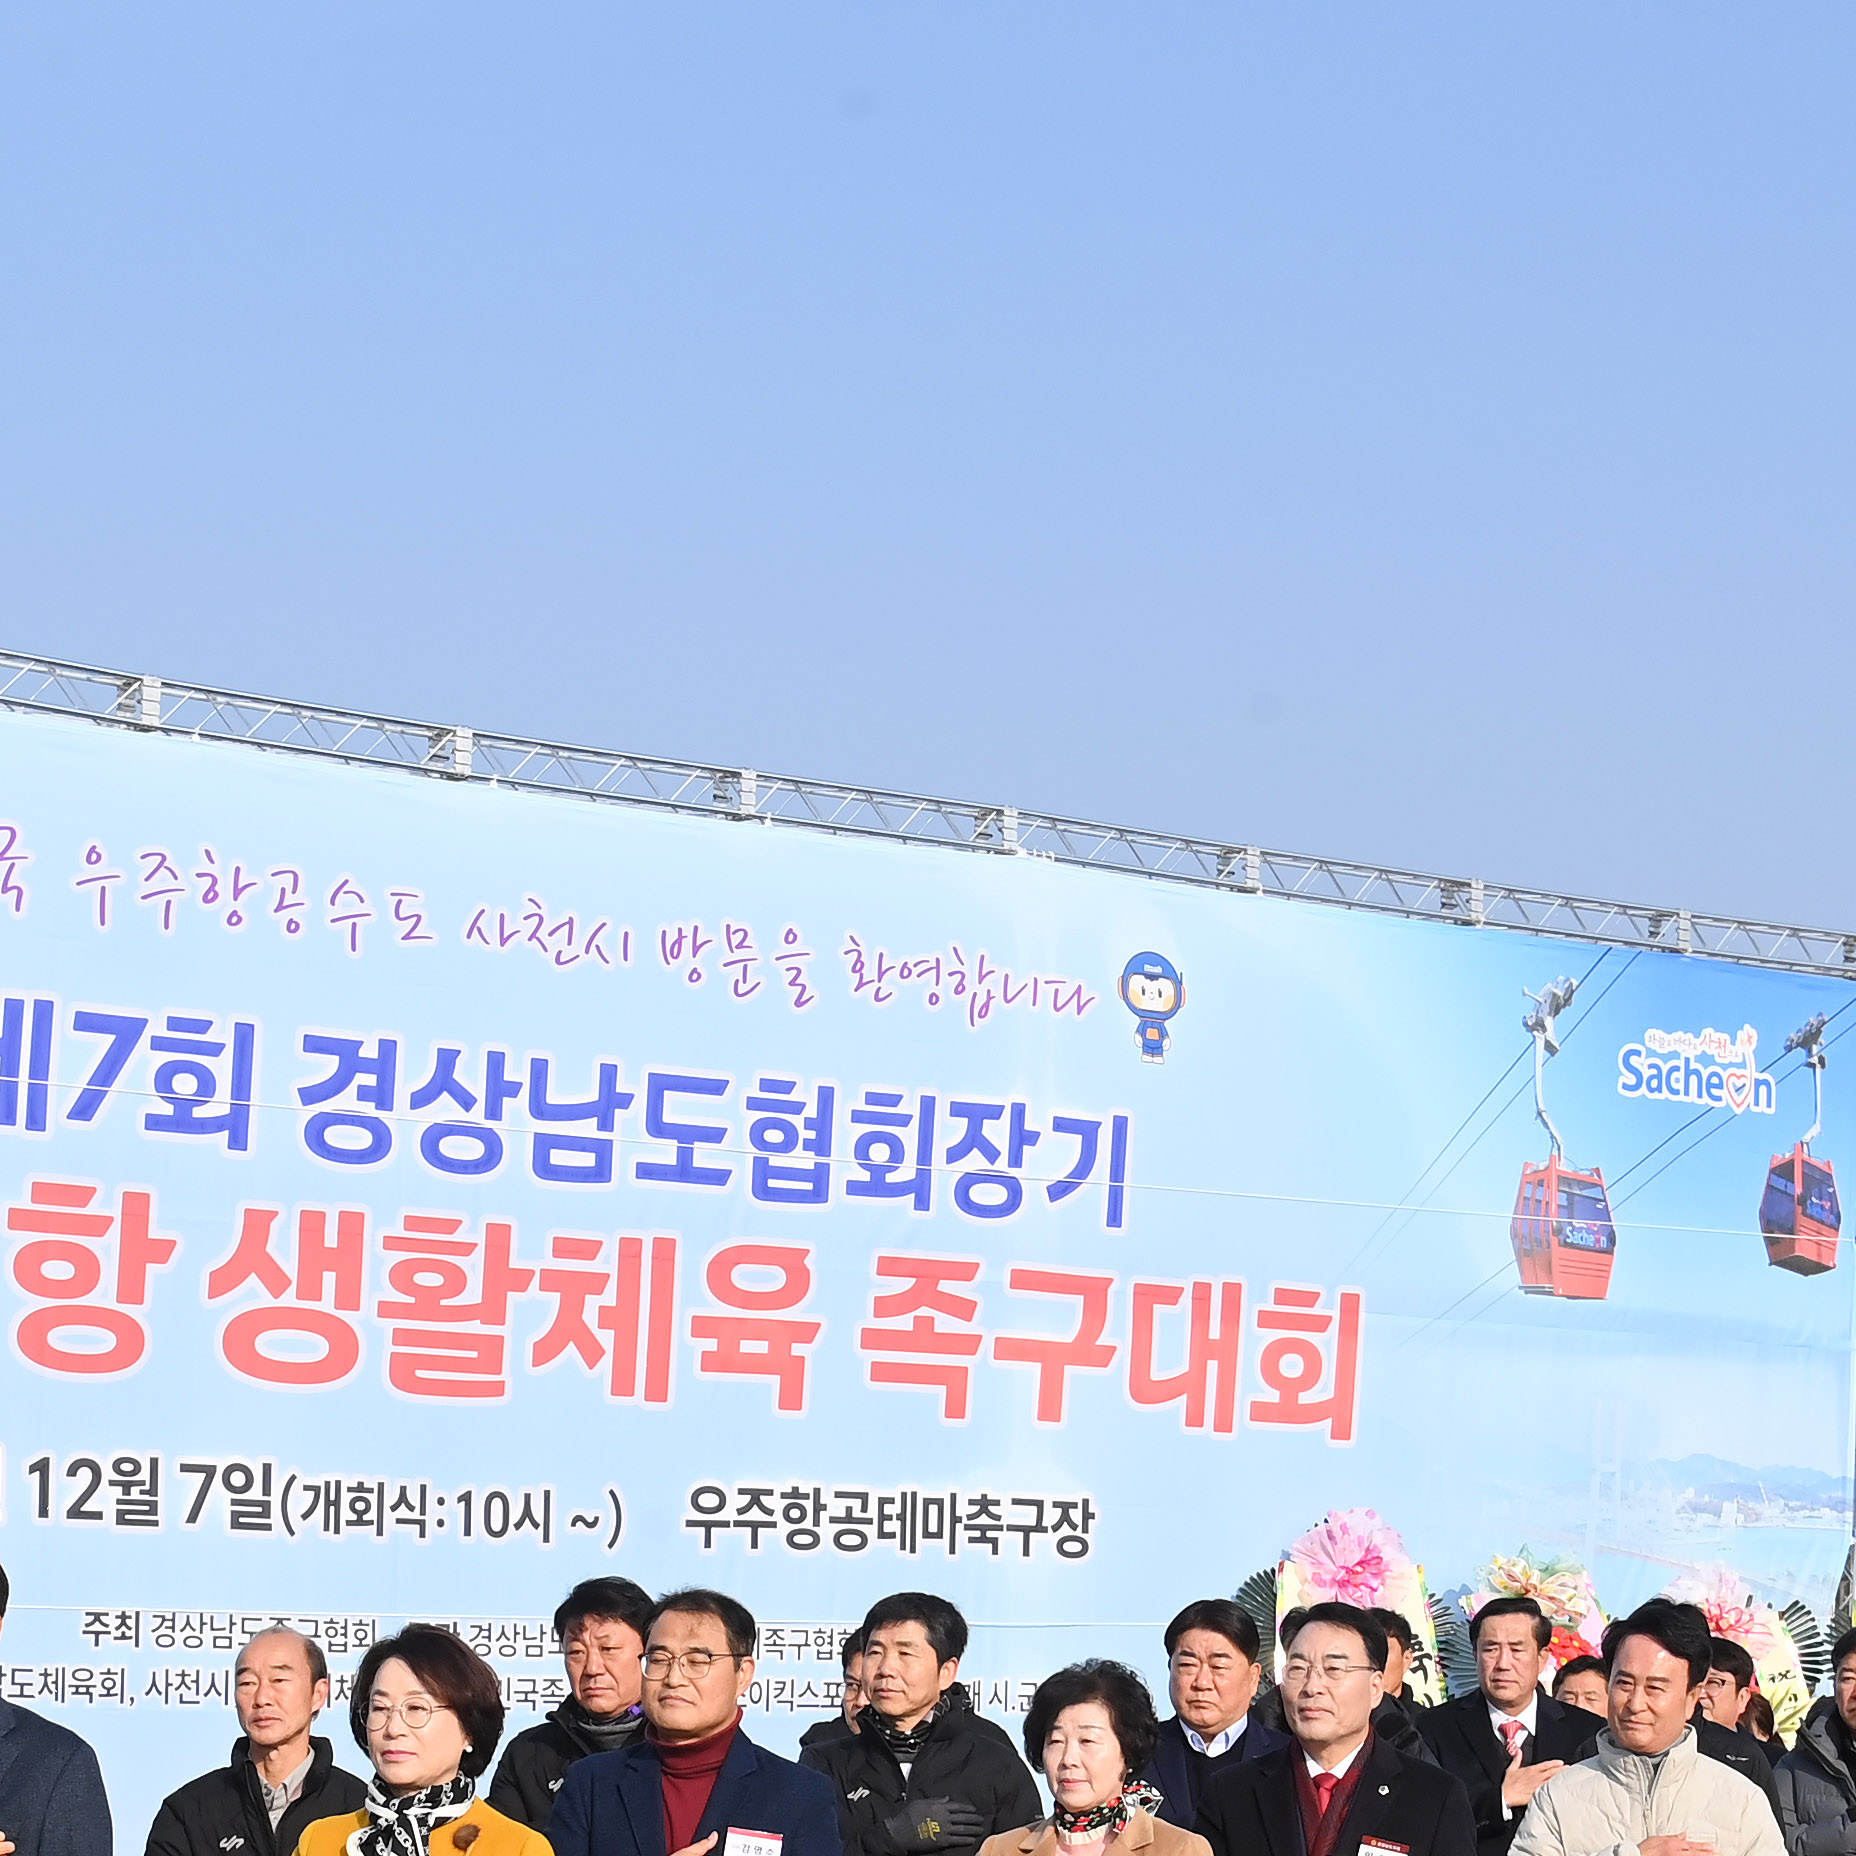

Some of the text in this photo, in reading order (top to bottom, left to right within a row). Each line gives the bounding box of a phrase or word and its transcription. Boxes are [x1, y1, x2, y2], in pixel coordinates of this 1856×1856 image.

[76, 844, 434, 952] 우주항공수도
[465, 897, 630, 968] 사천시
[658, 923, 815, 1009] 방문을
[843, 934, 1097, 1027] 환영합니다
[297, 1034, 1129, 1229] 경상남도협회장기
[207, 1207, 821, 1412] 생활체육
[859, 1254, 1364, 1443] 족구대회
[28, 1456, 160, 1527] 12월
[685, 1483, 1096, 1559] 우주항공테마축구장
[83, 1610, 140, 1648] 주최
